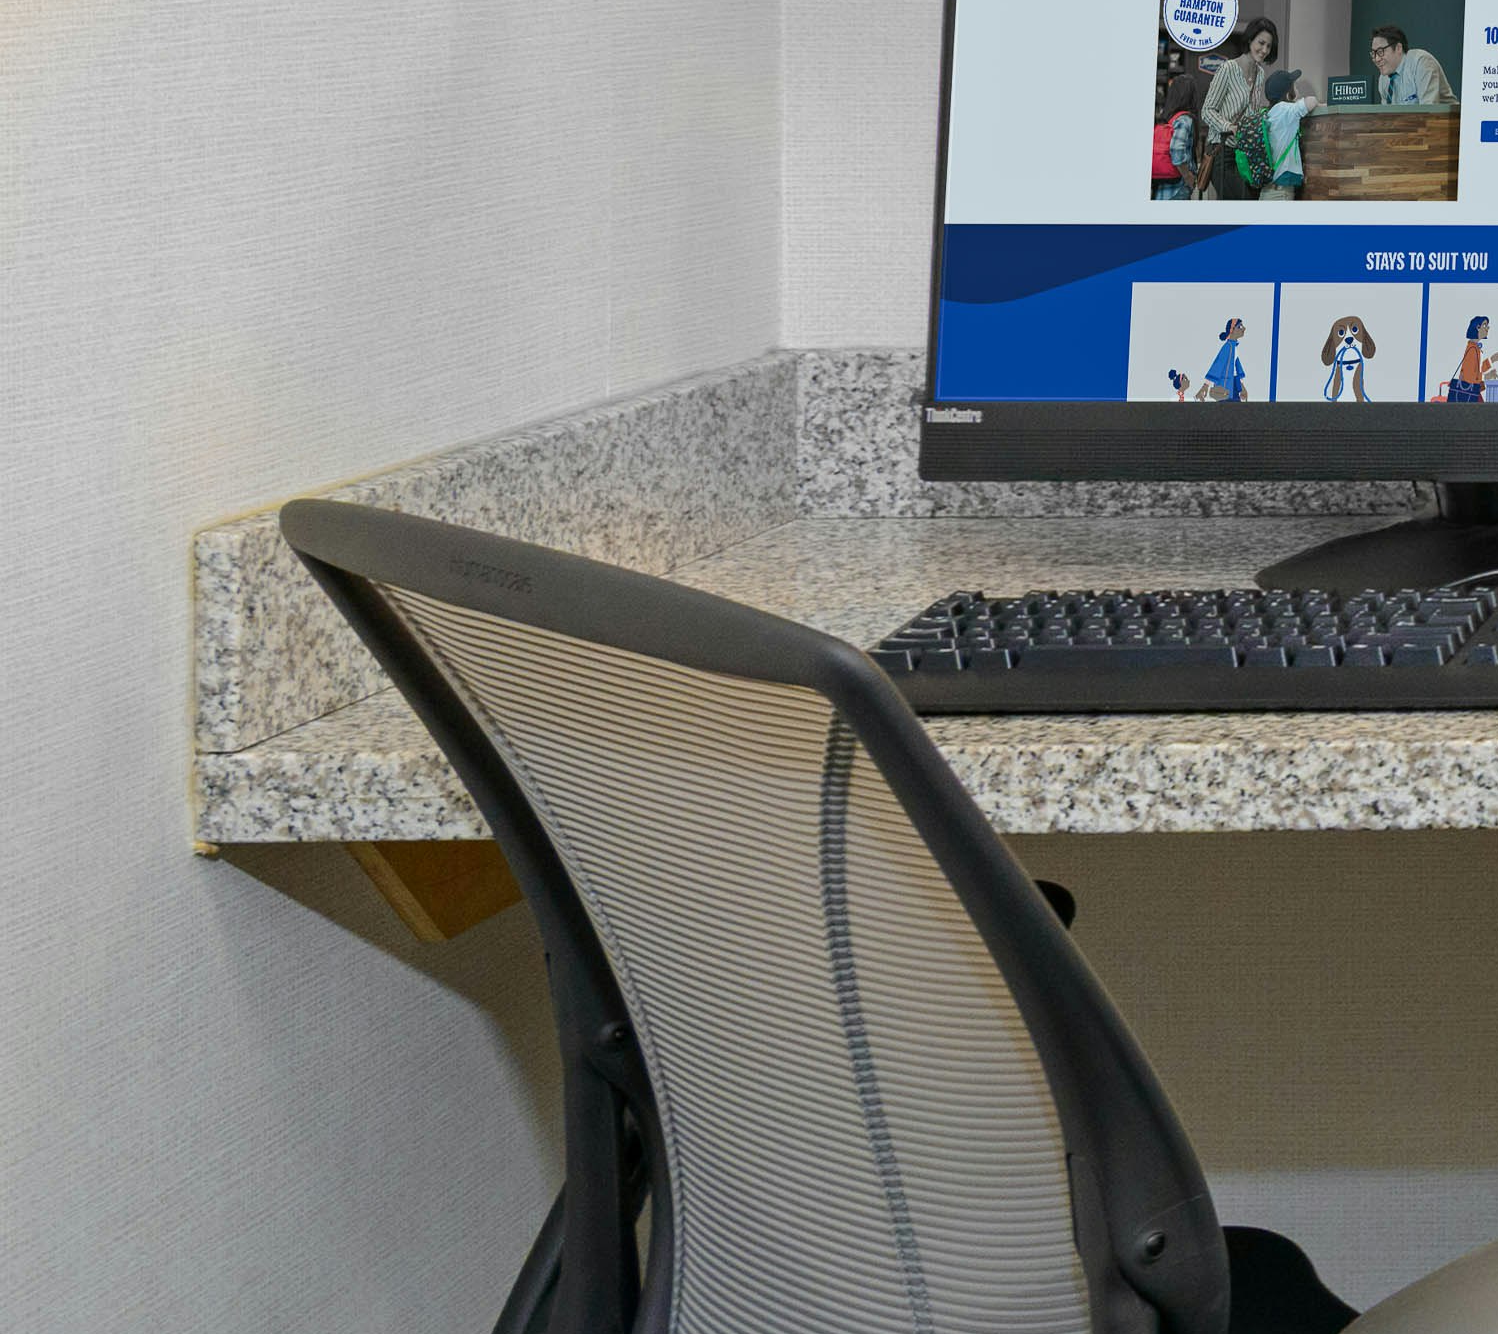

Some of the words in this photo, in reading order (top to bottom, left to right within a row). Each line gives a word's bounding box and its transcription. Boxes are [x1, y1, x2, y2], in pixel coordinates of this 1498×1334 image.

[1174, 9, 1226, 27] GUARANTEE
[1335, 84, 1364, 96] Hilton
[1366, 252, 1405, 271] STAYS
[1409, 252, 1425, 271] TO
[1428, 252, 1458, 271] SUIT
[1462, 252, 1488, 271] YOU
